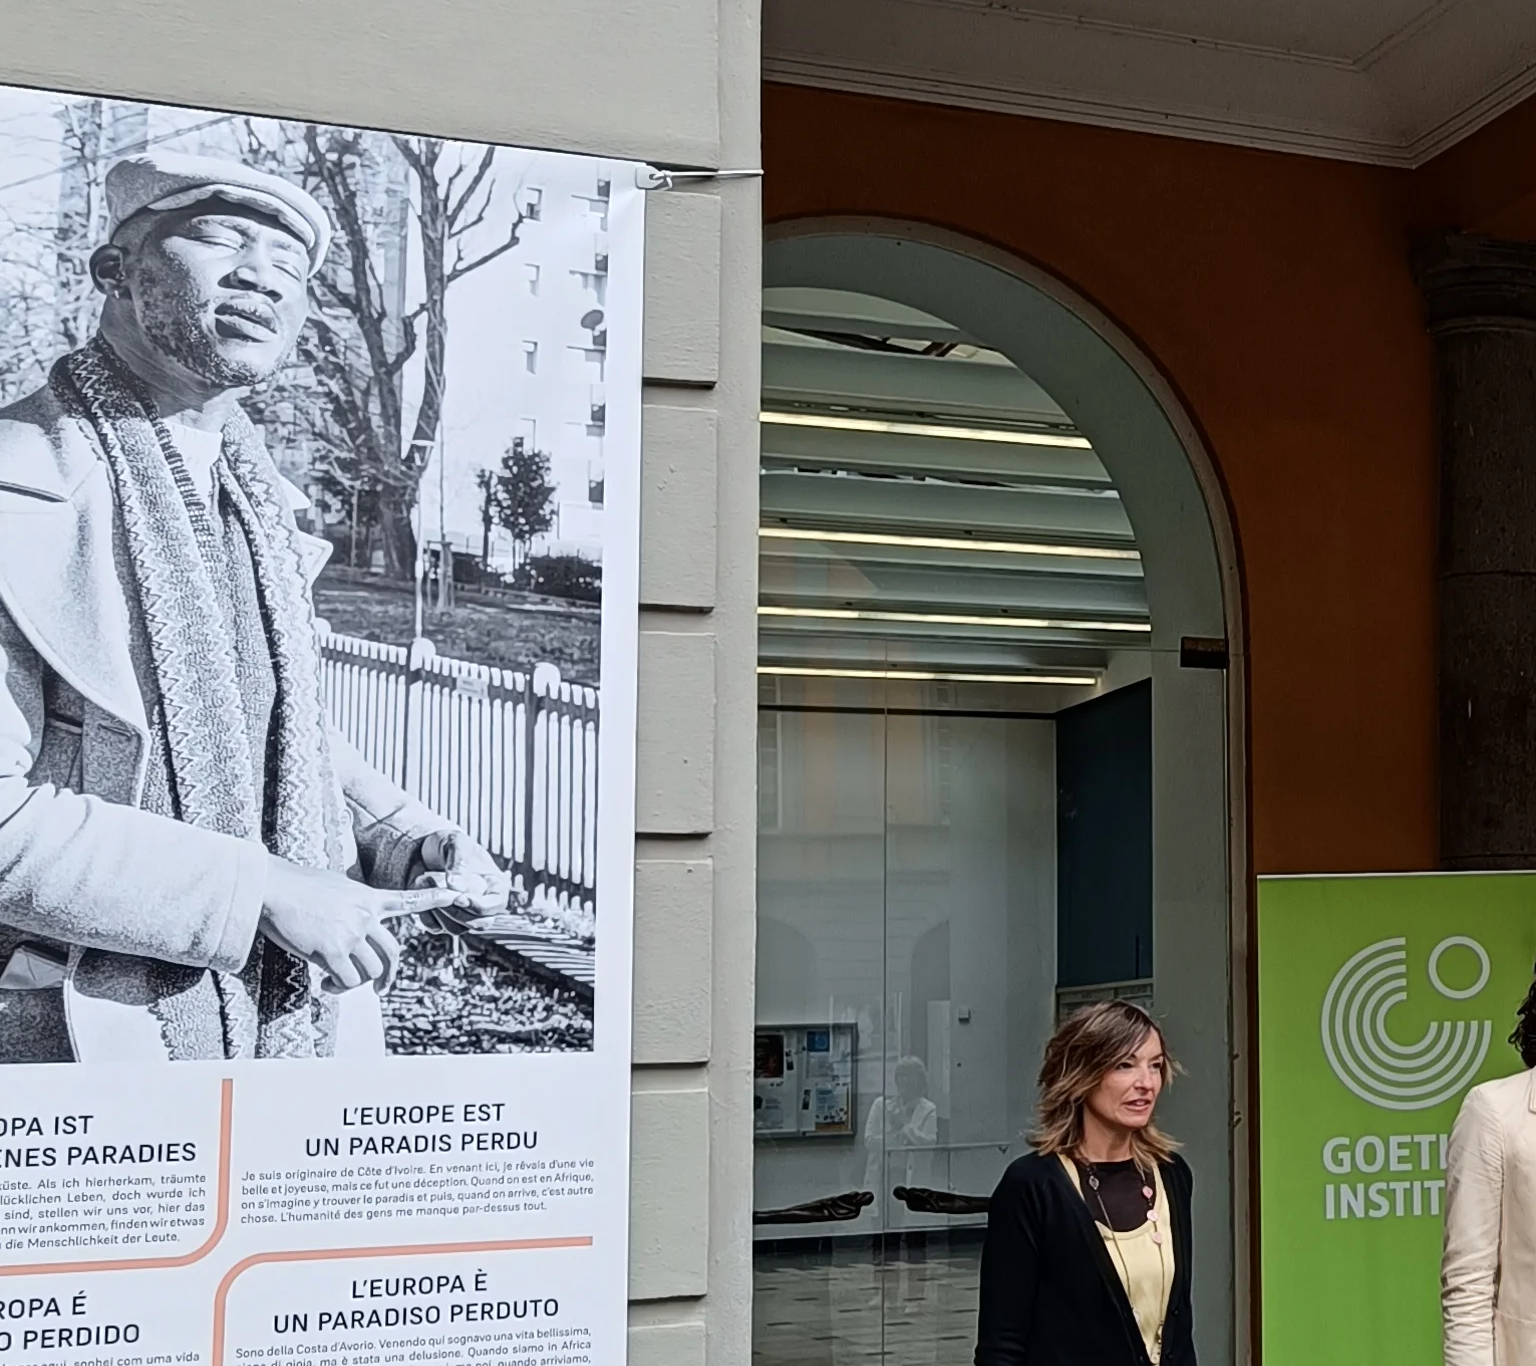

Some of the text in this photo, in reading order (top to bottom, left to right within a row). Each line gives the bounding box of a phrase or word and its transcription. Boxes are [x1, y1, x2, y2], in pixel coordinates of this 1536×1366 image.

[54, 1115, 94, 1135] IST
[343, 1103, 505, 1126] L'EUROPE EST
[0, 1143, 196, 1168] NES PARADIES
[306, 1131, 537, 1156] UN PARADIS PERDU
[1325, 1179, 1445, 1219] INSTIT
[352, 1269, 488, 1299] L'EUROPA È
[72, 1290, 87, 1316] É
[274, 1298, 559, 1333] UN PARADISO PERDUTO
[23, 1324, 140, 1350] PERDIDO
